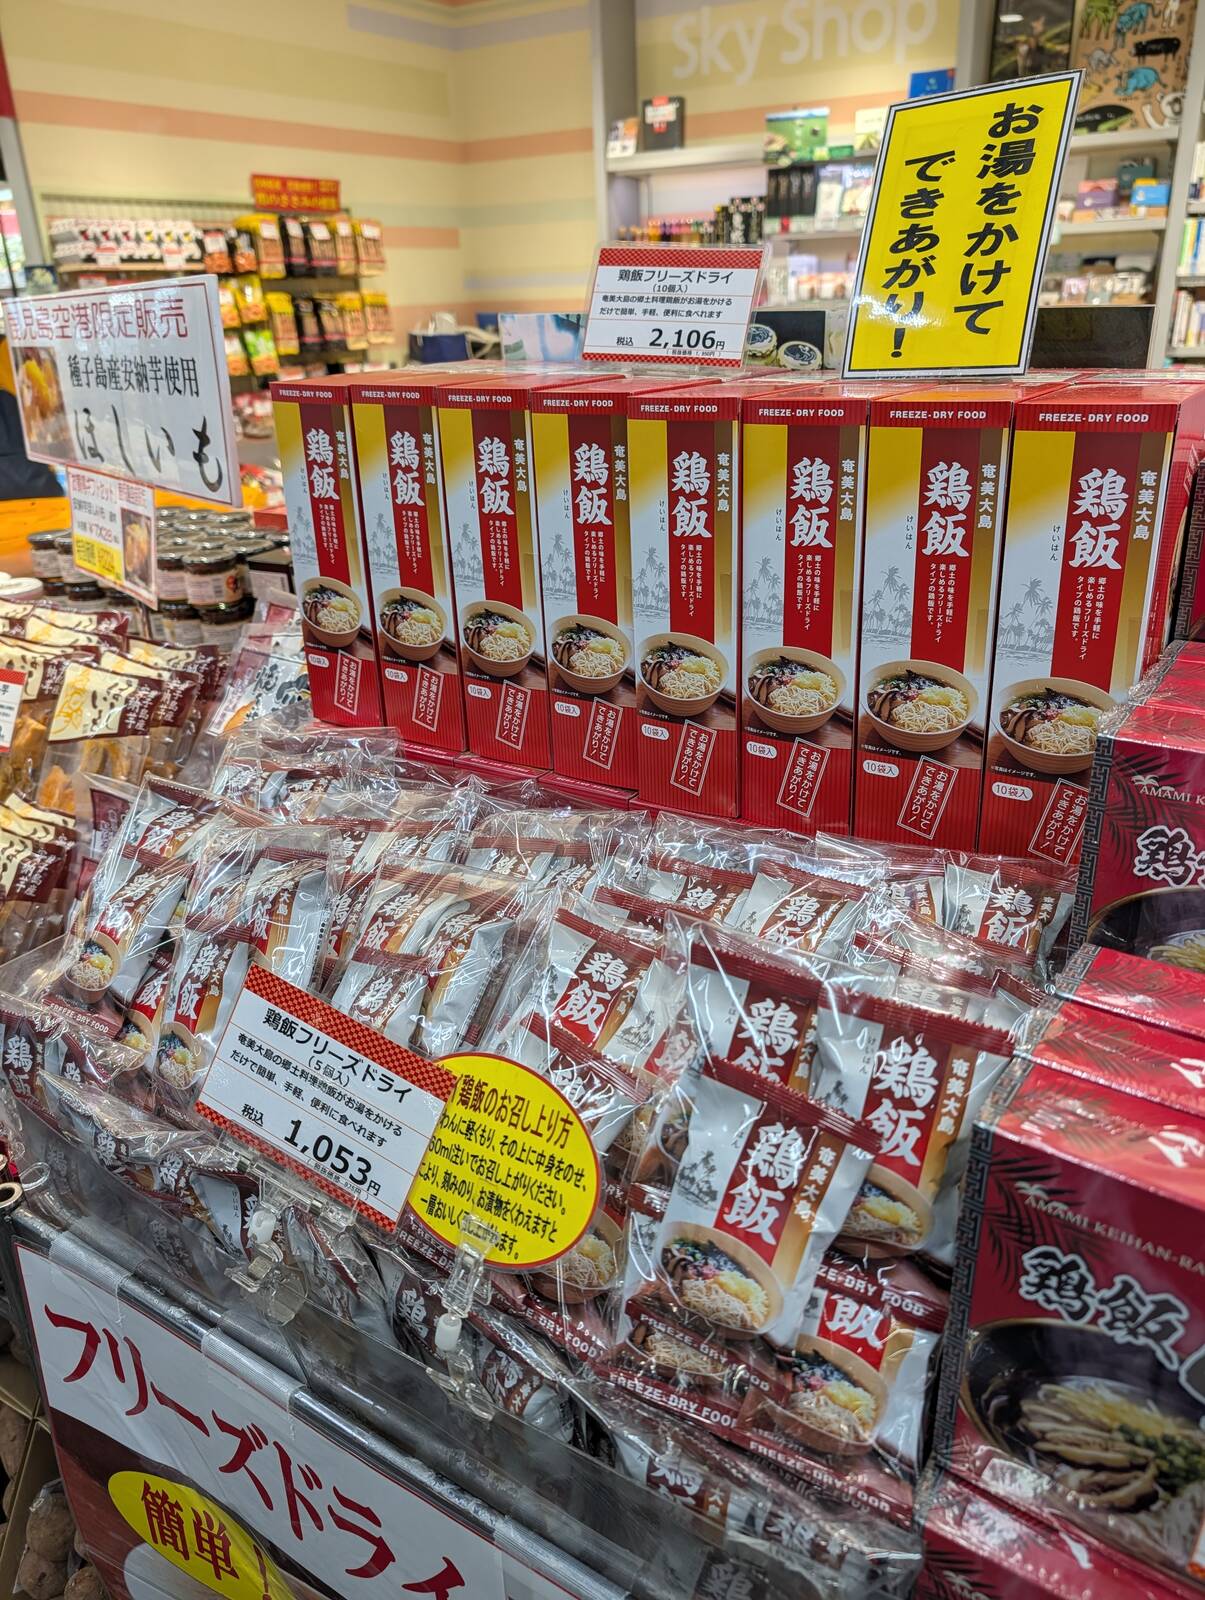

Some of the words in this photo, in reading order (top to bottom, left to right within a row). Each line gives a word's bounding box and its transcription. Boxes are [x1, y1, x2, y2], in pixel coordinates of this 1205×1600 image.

[671, 4, 766, 86] Sky
[782, 0, 938, 64] Shop
[952, 102, 1044, 336] お湯をかけて
[617, 269, 734, 285] 鶏飯フリーズドライ
[879, 150, 956, 358] できあがり!
[599, 307, 723, 320] だけで簡単、手軽、便利に食べれます
[601, 294, 733, 307] 奄美大島の郷土料理鶏飯がお湯をかける
[616, 336, 634, 347] 税込
[649, 327, 726, 351] 2,106円
[67, 354, 199, 398] 種子島産安納芋使用
[694, 405, 718, 413] FOOD
[818, 409, 844, 417] FOOD
[957, 410, 986, 419] FOOD
[1116, 413, 1150, 422] FOOD
[74, 404, 223, 492] ほしいも
[306, 428, 340, 500] 鶏飯
[336, 430, 350, 480] 奄美大島
[390, 430, 425, 506] 鶏飯
[422, 432, 436, 485] 奄美大島
[477, 436, 515, 516] 鶏飯
[514, 438, 527, 492] 奄美大島
[614, 444, 627, 500] 奄美大島
[573, 443, 613, 526] 鶏飯
[671, 450, 712, 538] 鶏飯
[716, 452, 730, 512] 奄美大島
[789, 456, 834, 548] 鶏飯
[840, 458, 856, 521] 奄美大島
[921, 461, 973, 558] 鶏飯
[977, 464, 997, 530] 奄美大島
[1132, 470, 1158, 541] 奄美大島
[1050, 526, 1060, 562] けいはん
[1068, 468, 1128, 570] 鶏飯
[1078, 576, 1096, 660] 楽しめるフリーズドライ
[1092, 577, 1106, 640] 郷土の味を手軽に
[747, 743, 775, 756] 10袋入
[865, 762, 896, 776] 10袋入
[918, 771, 947, 830] お湯をかけて
[995, 784, 1030, 798] 10袋入
[1040, 790, 1074, 850] できあがり!
[1139, 786, 1191, 803] AMAMI
[1054, 794, 1088, 857] お湯をかけて
[176, 944, 220, 1020] 鶏飯
[558, 952, 631, 1031] 鶏飯
[237, 1033, 403, 1137] 奄美大島の郷土料理鶏飯がお湯をかける
[262, 1007, 412, 1104] 鶏飯フリーズドライ
[307, 1056, 351, 1087] (5個入)
[229, 1049, 387, 1148] だけで簡単、手軽、便利に食べれます
[866, 1044, 941, 1167] 鶏飯
[936, 1058, 972, 1135] 奄美大島
[241, 1103, 264, 1126] 税込
[284, 1119, 382, 1197] 1,053円
[722, 1120, 807, 1245] 鶏飯
[1024, 1193, 1090, 1231] AMAMI
[816, 1265, 878, 1297] ZE-DRY
[1018, 1245, 1189, 1372] 鶏飯
[564, 1331, 598, 1358] FOOD
